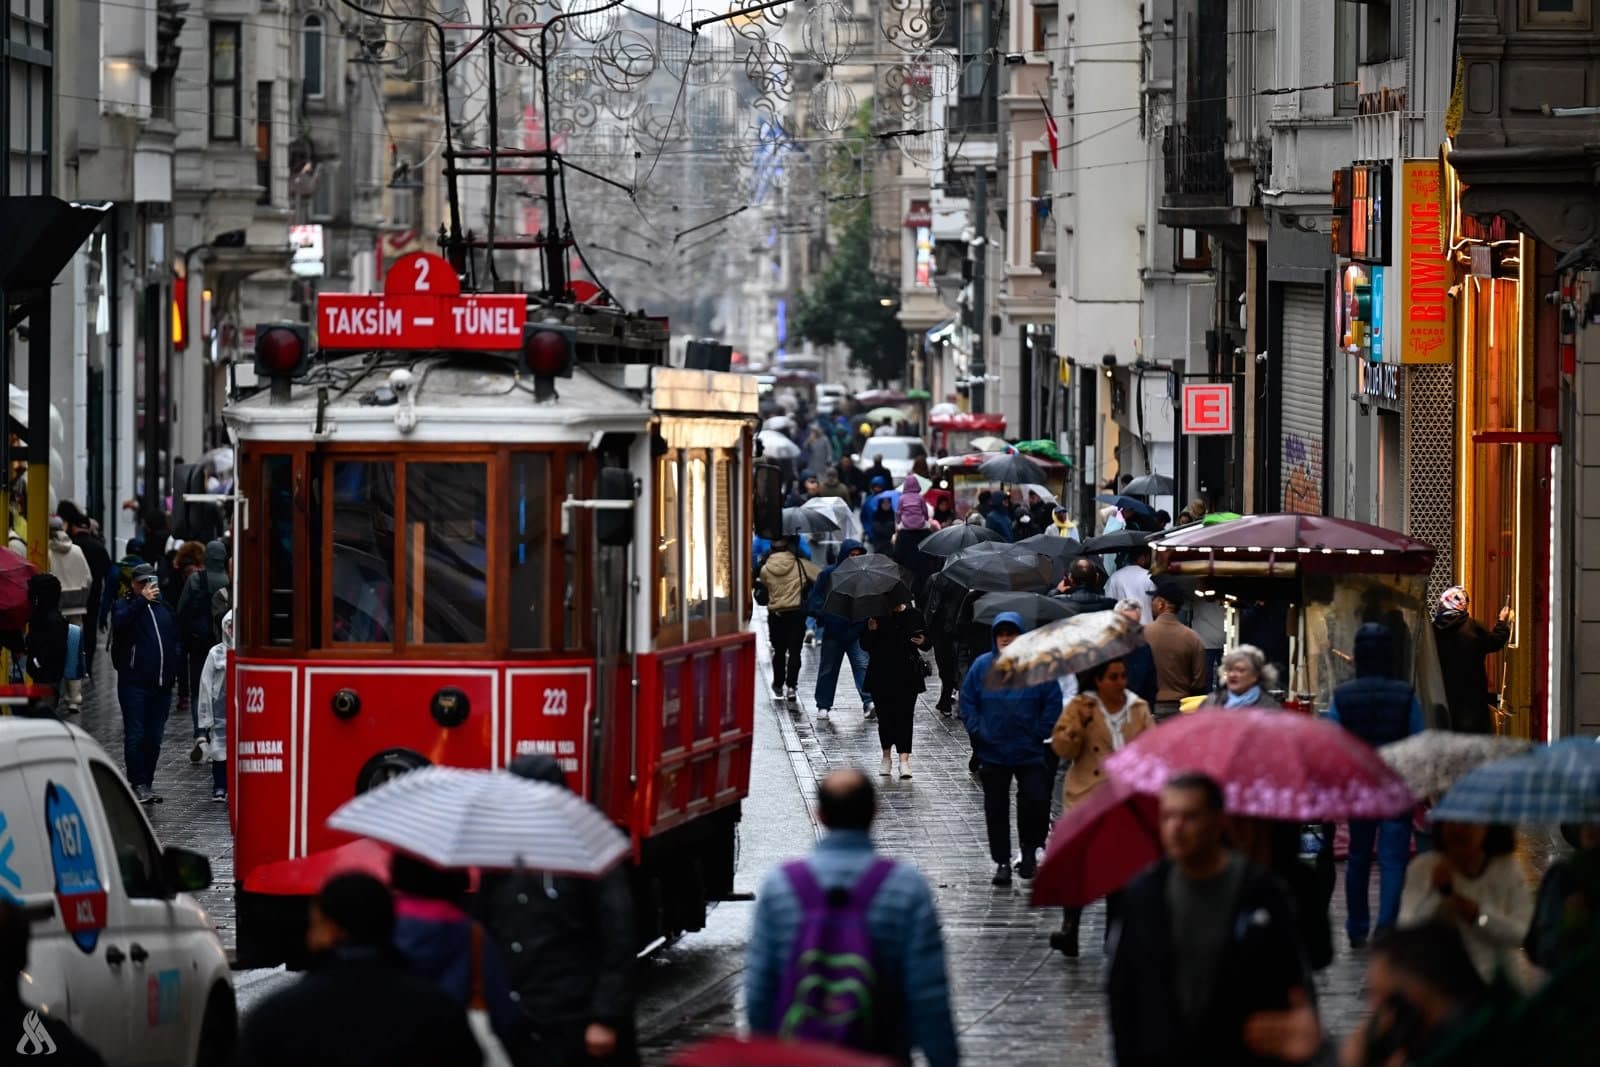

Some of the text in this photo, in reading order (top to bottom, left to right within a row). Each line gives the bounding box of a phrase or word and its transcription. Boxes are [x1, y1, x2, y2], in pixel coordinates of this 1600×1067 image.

[414, 257, 430, 291] 2
[1409, 202, 1446, 323] BOWLING
[325, 301, 403, 336] TAKSİM
[451, 301, 521, 335] TÜNEL
[1409, 327, 1445, 336] ARCADE
[1194, 394, 1220, 424] E
[245, 686, 265, 714] 223
[542, 687, 568, 716] 223
[256, 740, 284, 756] YASAK
[55, 813, 83, 857] 187
